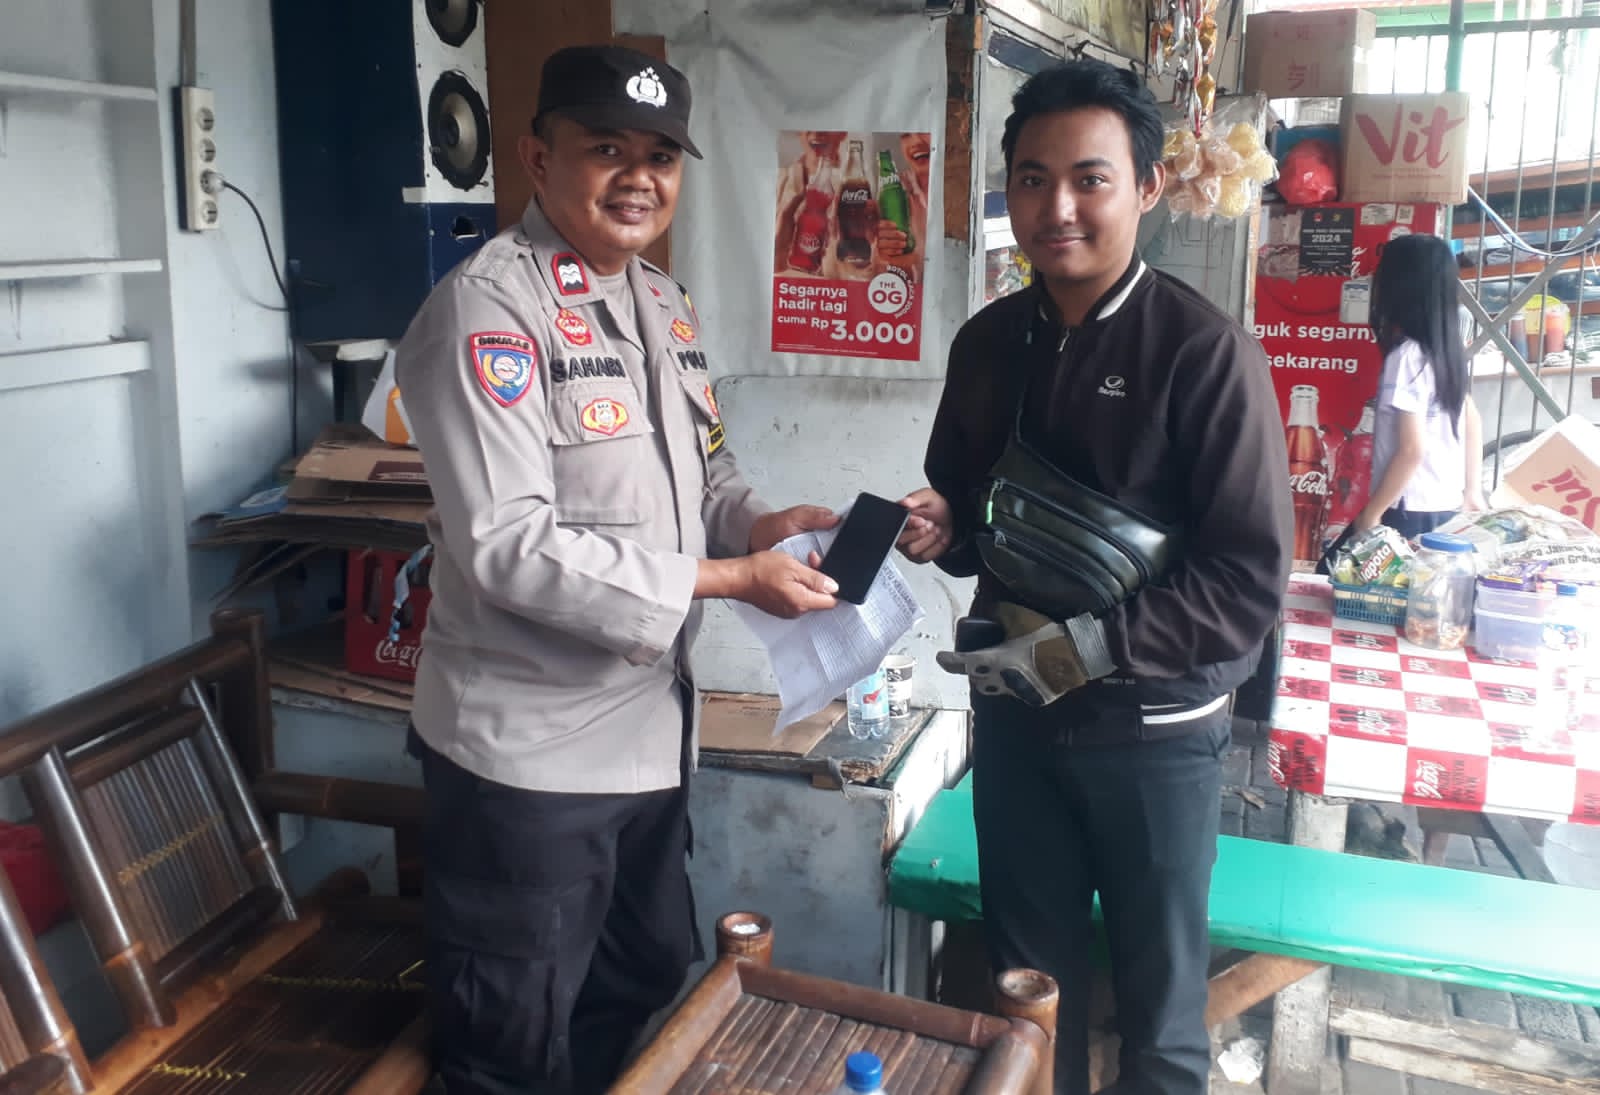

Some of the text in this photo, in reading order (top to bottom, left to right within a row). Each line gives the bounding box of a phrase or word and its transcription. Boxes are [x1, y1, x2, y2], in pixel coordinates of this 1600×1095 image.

[1355, 103, 1465, 168] Vit
[1311, 234, 1341, 243] 2024
[779, 283, 848, 298] Segarnya
[872, 290, 902, 304] OG
[778, 297, 847, 314] hadir lagi
[777, 315, 914, 344] cuma Rp 3.000
[1254, 322, 1291, 339] guk
